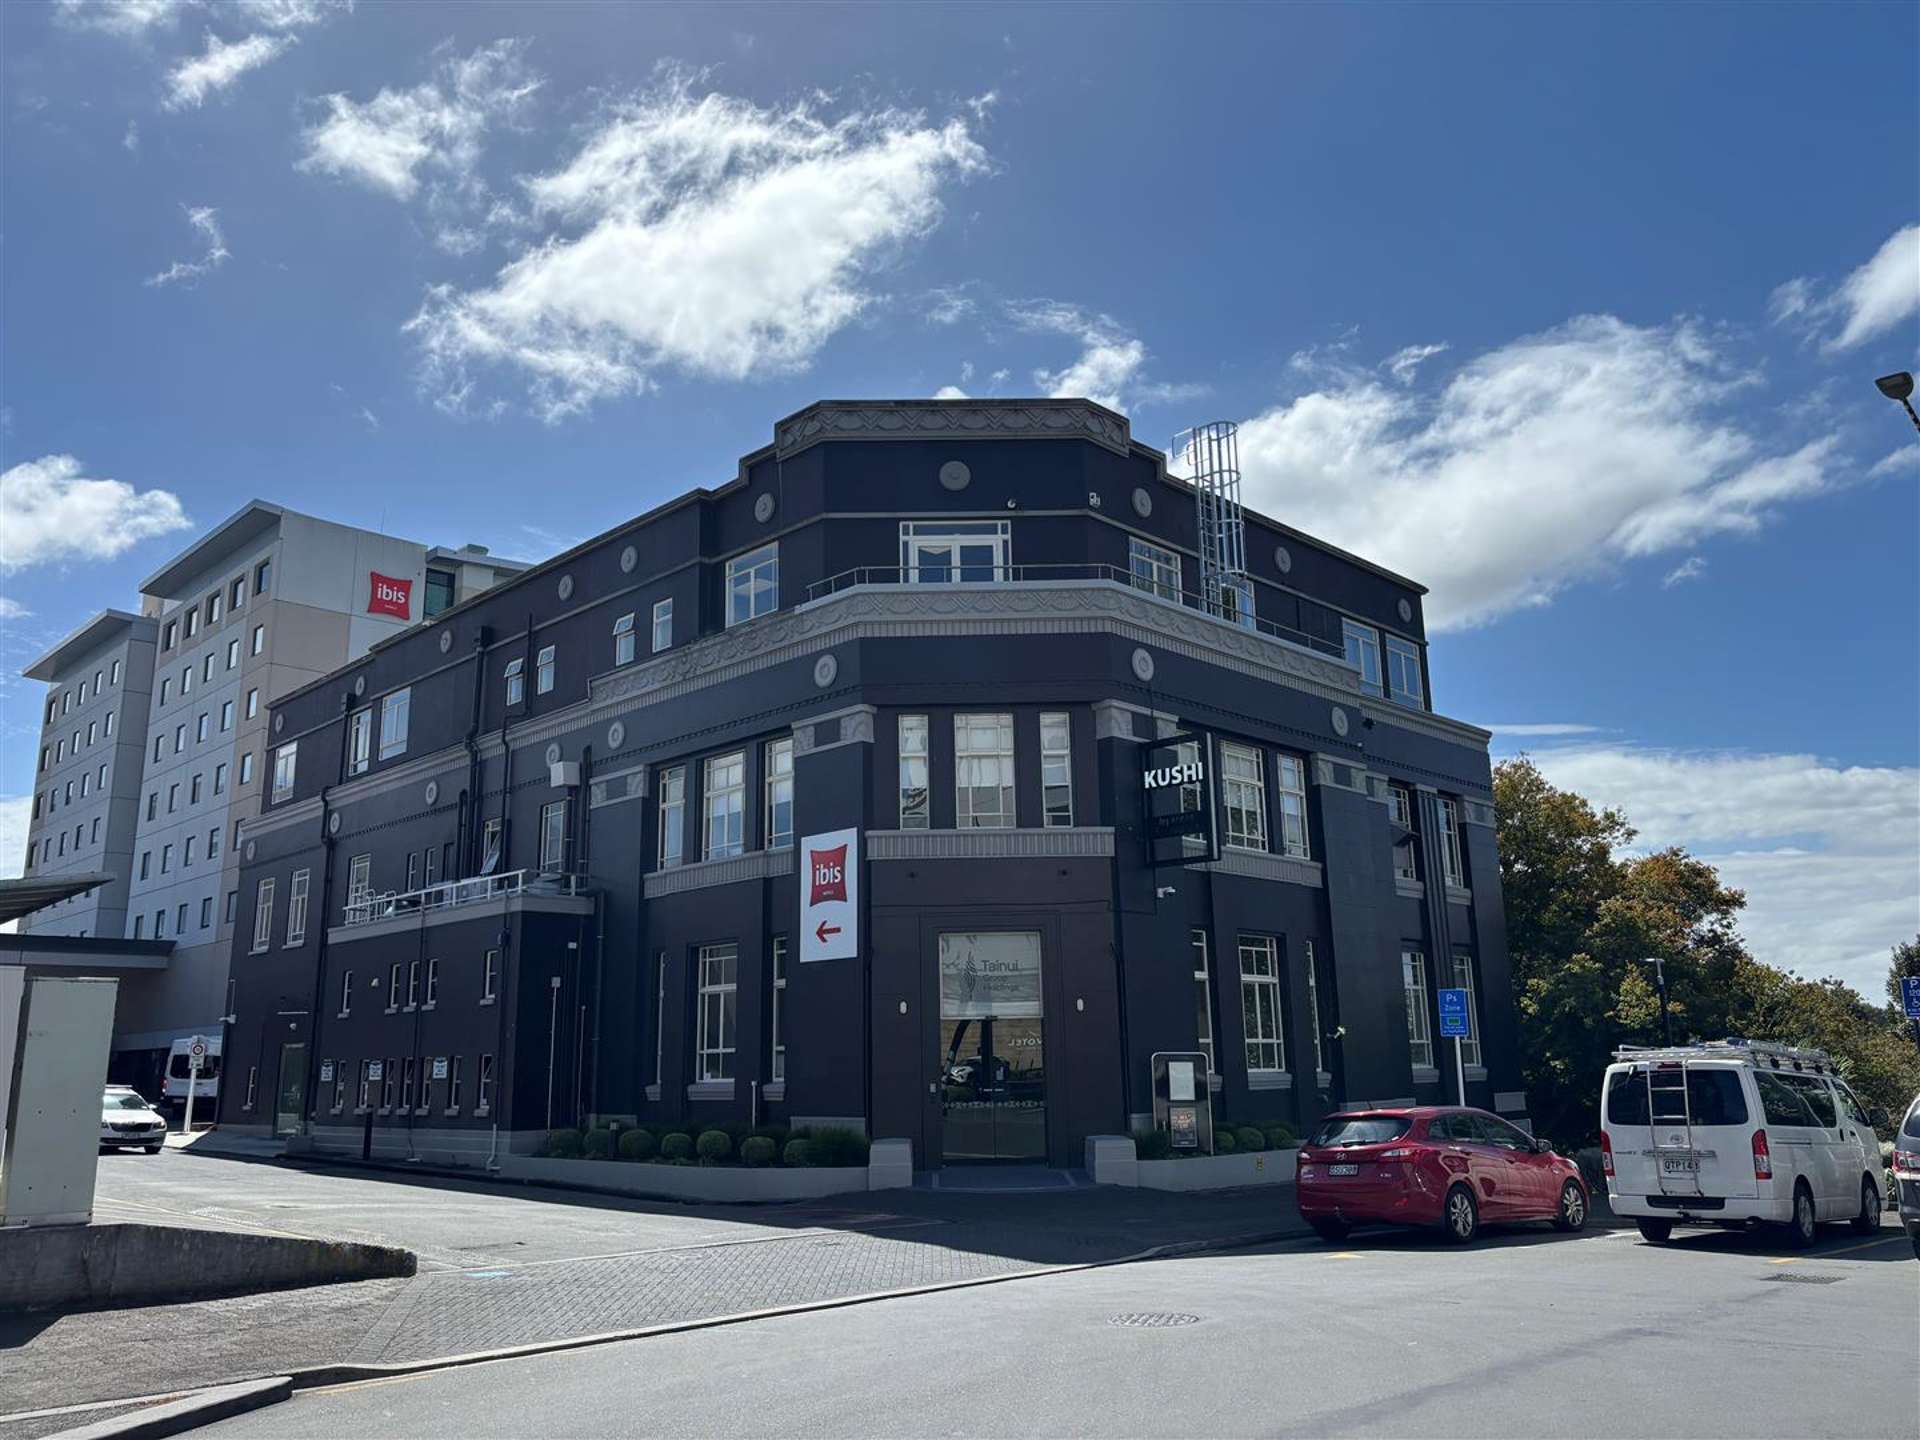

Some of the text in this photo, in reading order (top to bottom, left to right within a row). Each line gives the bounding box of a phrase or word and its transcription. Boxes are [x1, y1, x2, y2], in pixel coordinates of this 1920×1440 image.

[377, 583, 406, 604] ibis
[1144, 762, 1203, 789] KUSHI
[815, 862, 842, 886] ibis
[981, 959, 1019, 972] Tainui
